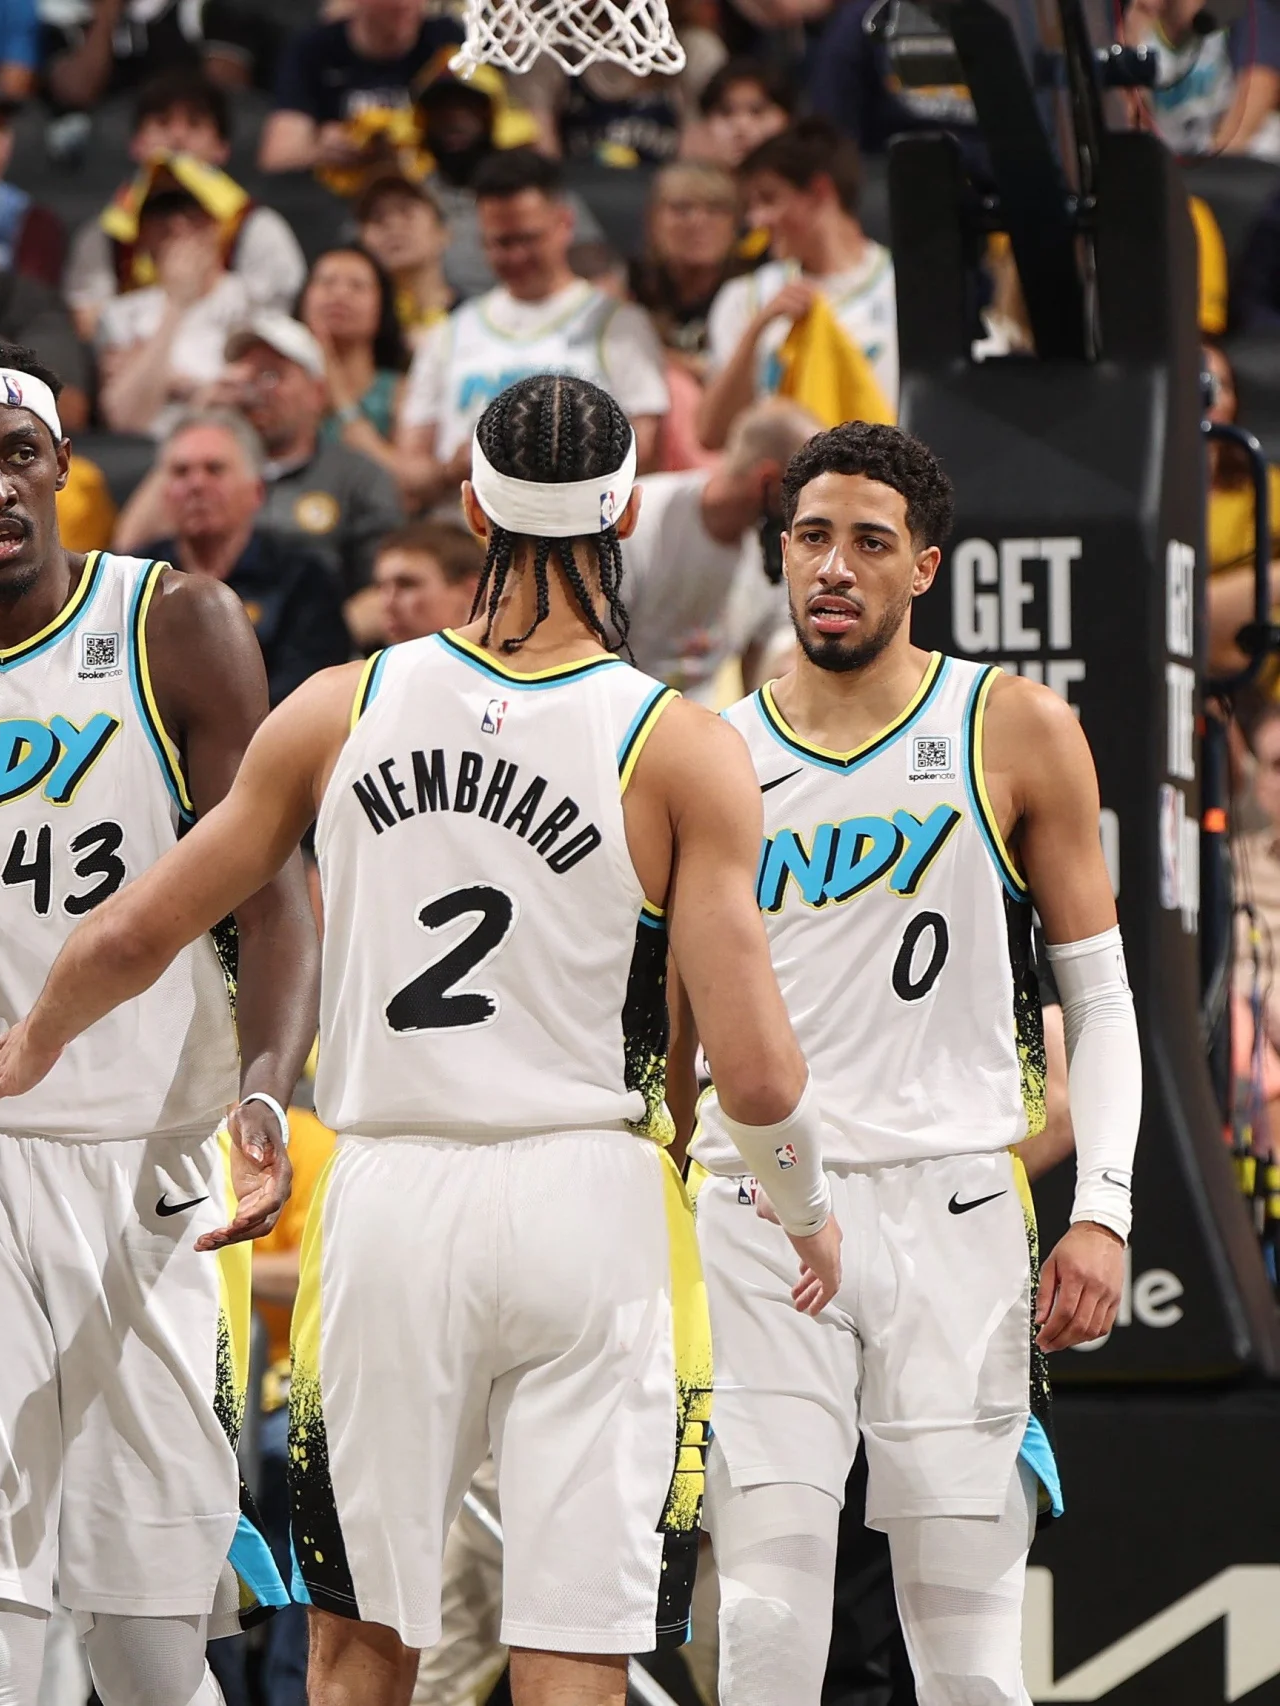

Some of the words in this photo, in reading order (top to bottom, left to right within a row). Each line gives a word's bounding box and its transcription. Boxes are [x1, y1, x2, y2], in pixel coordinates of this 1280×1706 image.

[951, 536, 1082, 653] GET
[78, 669, 123, 680] spokenote
[353, 749, 602, 874] NEMBHARD
[909, 772, 956, 782] spokenote
[2, 822, 126, 915] 43
[385, 885, 514, 1032] 2
[891, 910, 949, 1001] 0
